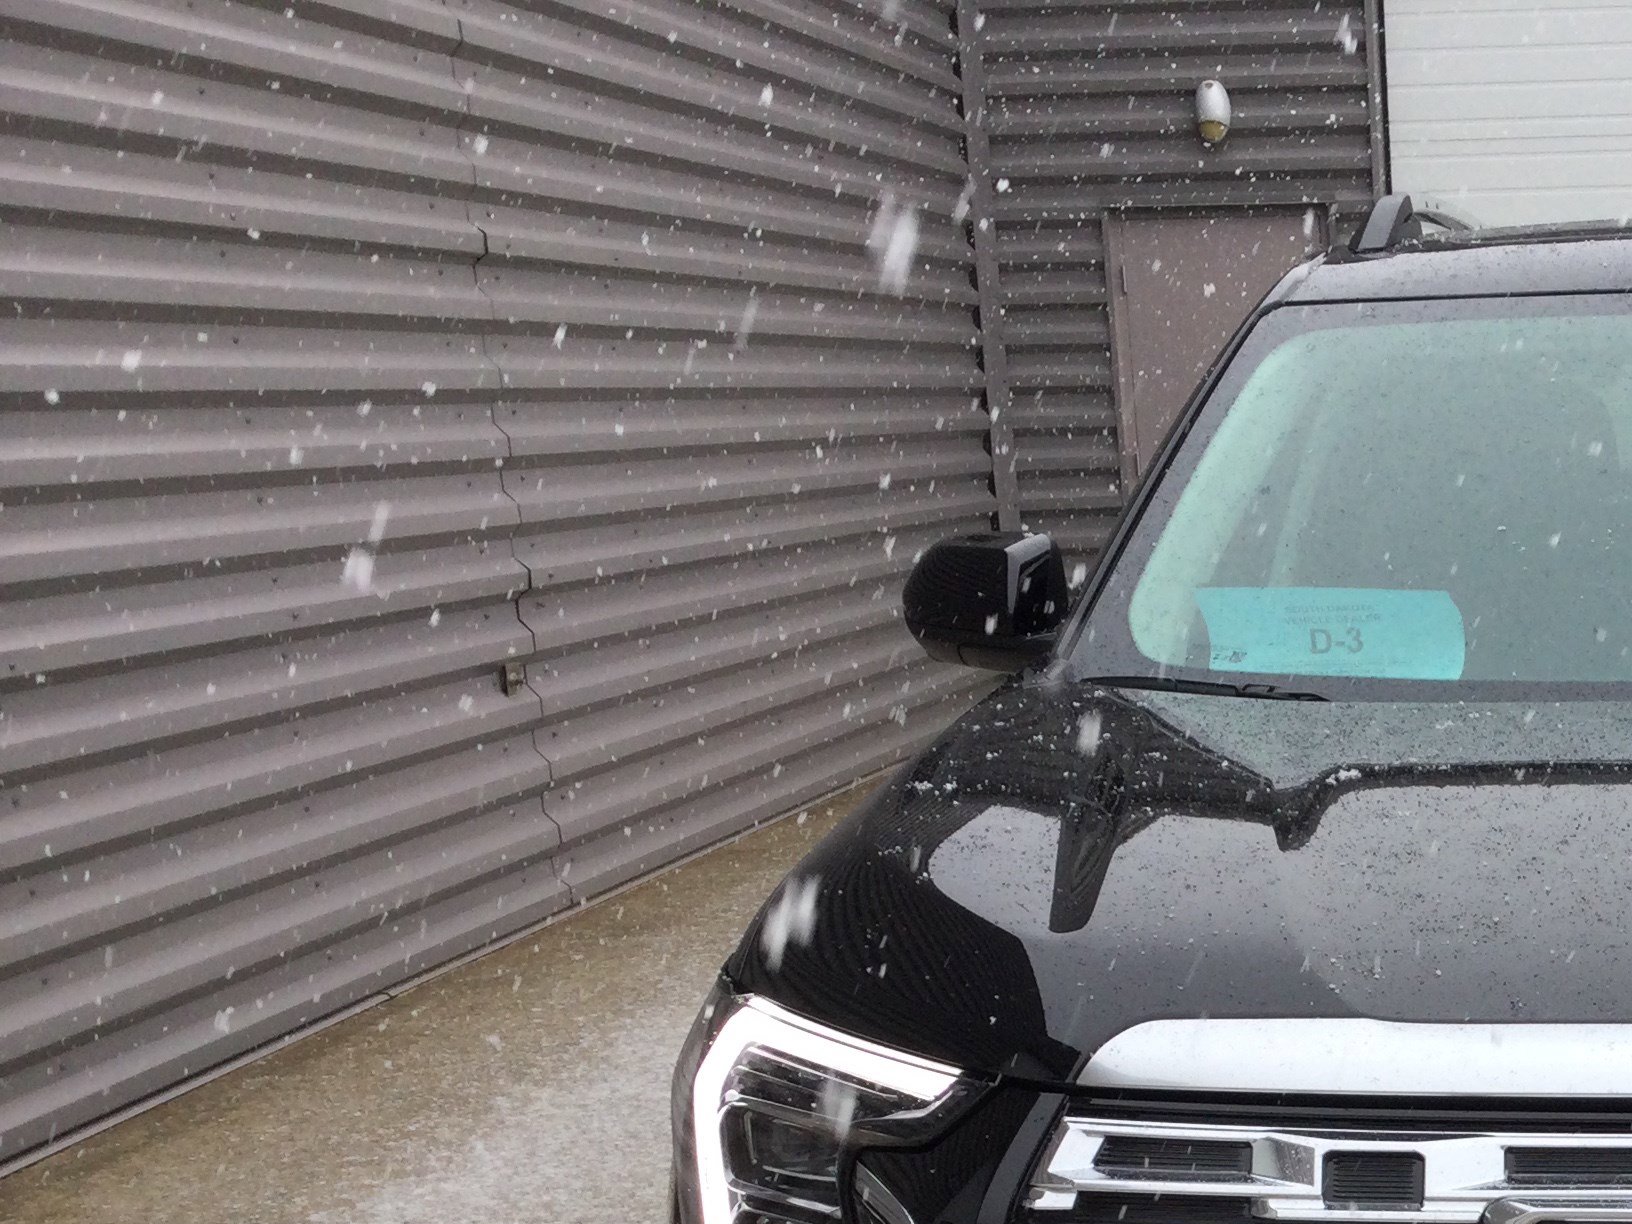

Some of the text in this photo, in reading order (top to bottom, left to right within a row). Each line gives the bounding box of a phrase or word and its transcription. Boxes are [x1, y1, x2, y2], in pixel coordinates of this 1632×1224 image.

[1284, 613, 1381, 625] VEHICLE DEALER
[1309, 626, 1364, 655] D-3
